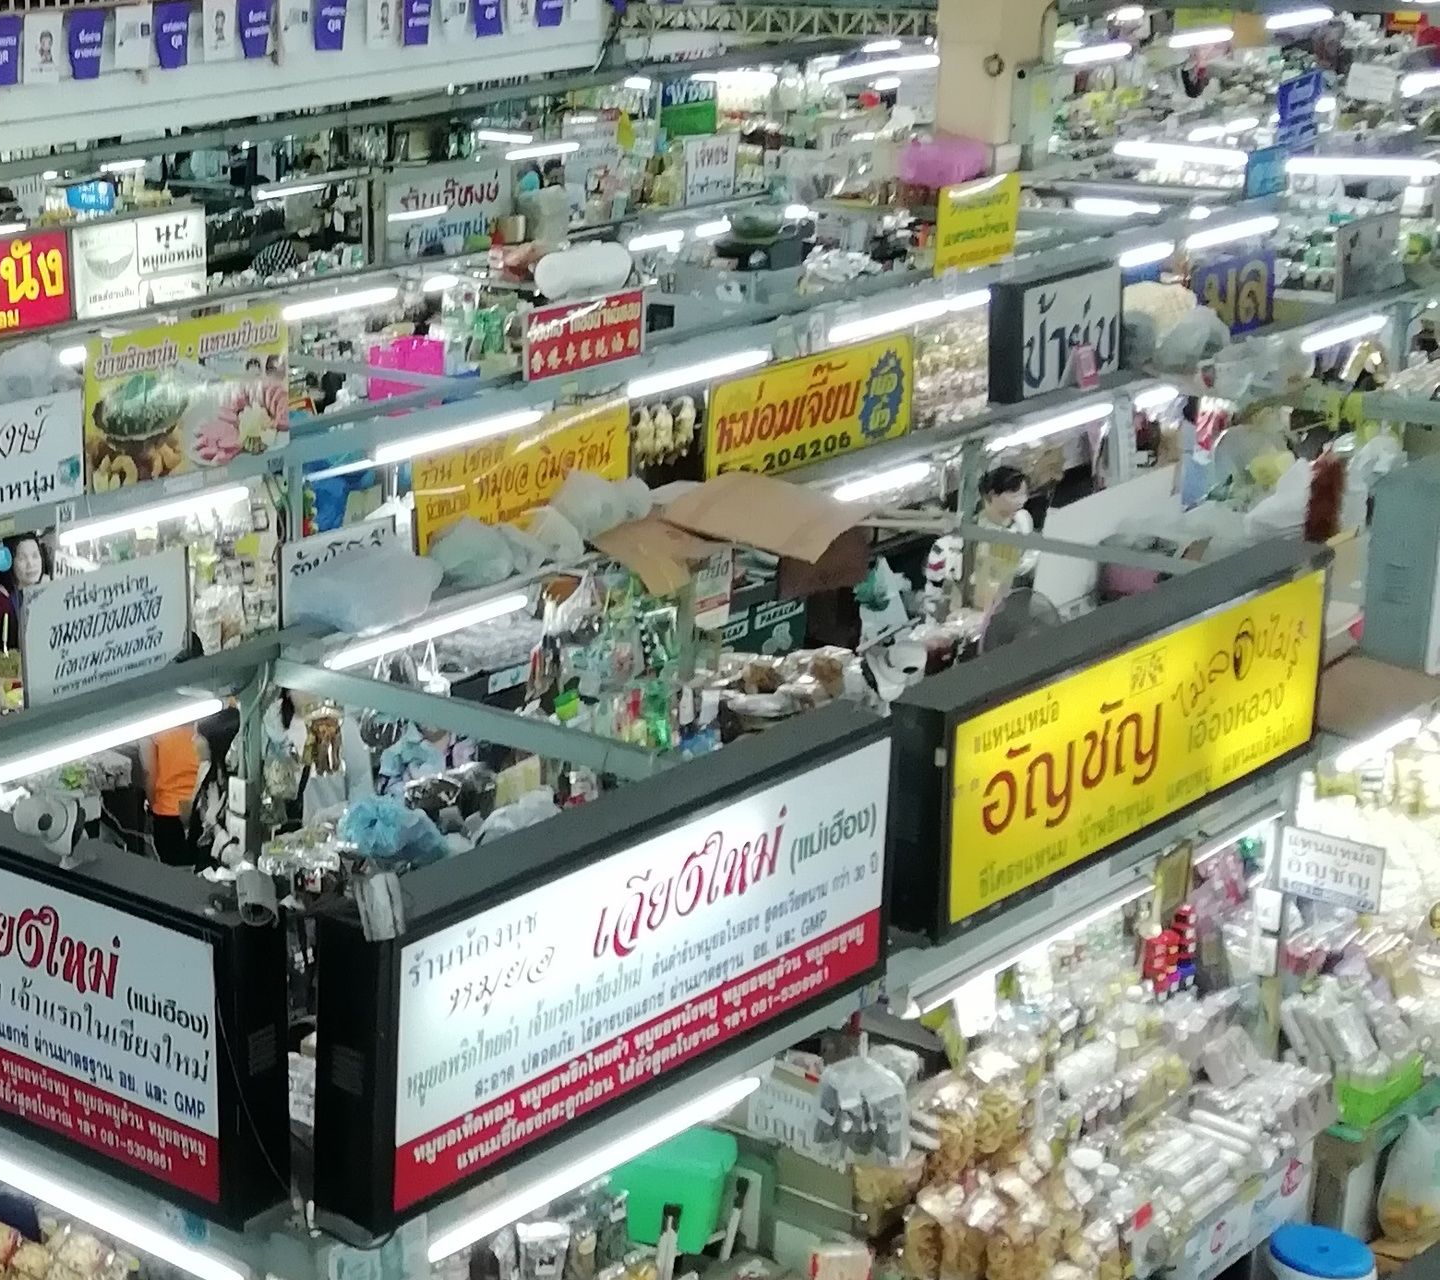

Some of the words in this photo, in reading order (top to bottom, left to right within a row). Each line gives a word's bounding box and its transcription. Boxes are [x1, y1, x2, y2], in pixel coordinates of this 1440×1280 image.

[981, 699, 1165, 836] อัญชัญ
[408, 910, 538, 988] ร้านน้องนุช
[11, 976, 210, 1085] เจ้าแรกในเชียงใหม่
[174, 1090, 206, 1120] GMP
